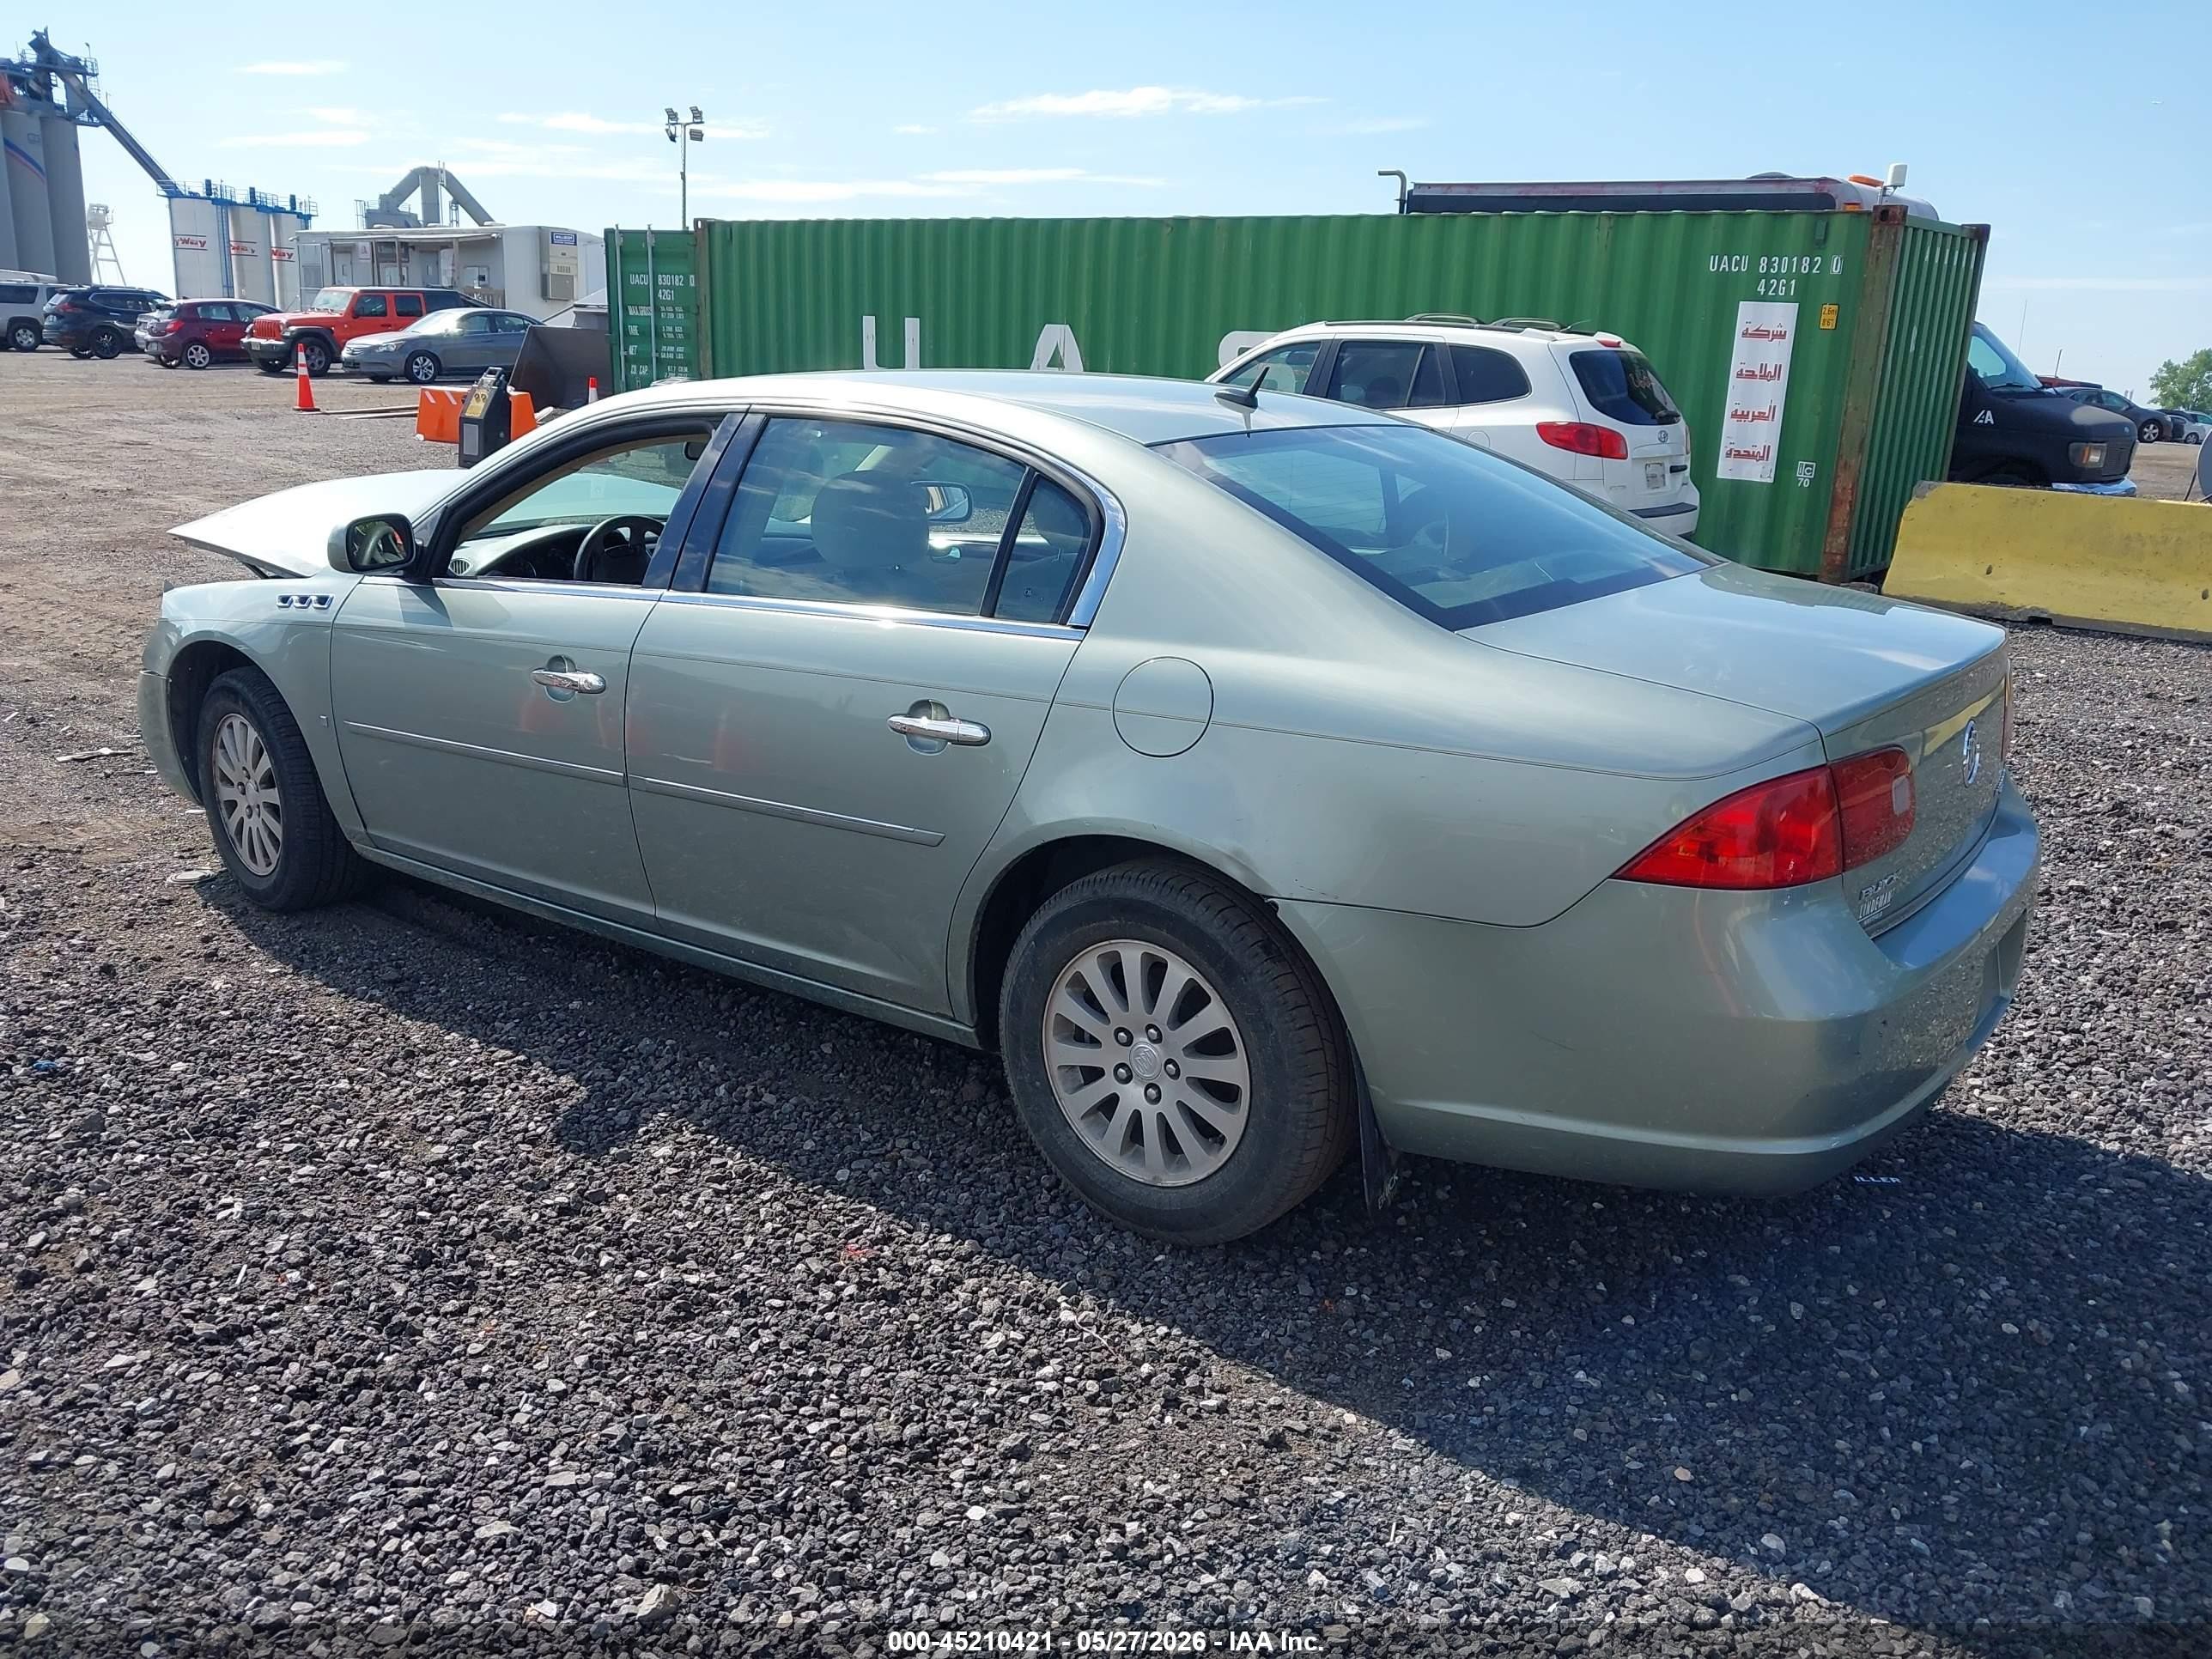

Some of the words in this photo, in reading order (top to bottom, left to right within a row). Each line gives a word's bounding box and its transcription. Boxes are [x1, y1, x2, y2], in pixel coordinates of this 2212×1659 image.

[1710, 255, 1748, 272] UACU
[1759, 257, 1821, 274] 830182
[1832, 256, 1842, 274] 0
[629, 274, 648, 285] UACU
[658, 274, 684, 286] 830182
[1757, 278, 1796, 296] 42G1
[658, 289, 674, 301] 42G1
[628, 325, 639, 336] TARE
[1741, 321, 1787, 342] شركة
[629, 345, 638, 356] NET
[1735, 362, 1782, 381] الملاحة
[1730, 402, 1776, 422] العربية
[1725, 442, 1771, 462] المتحدة
[1798, 477, 1809, 488] 70
